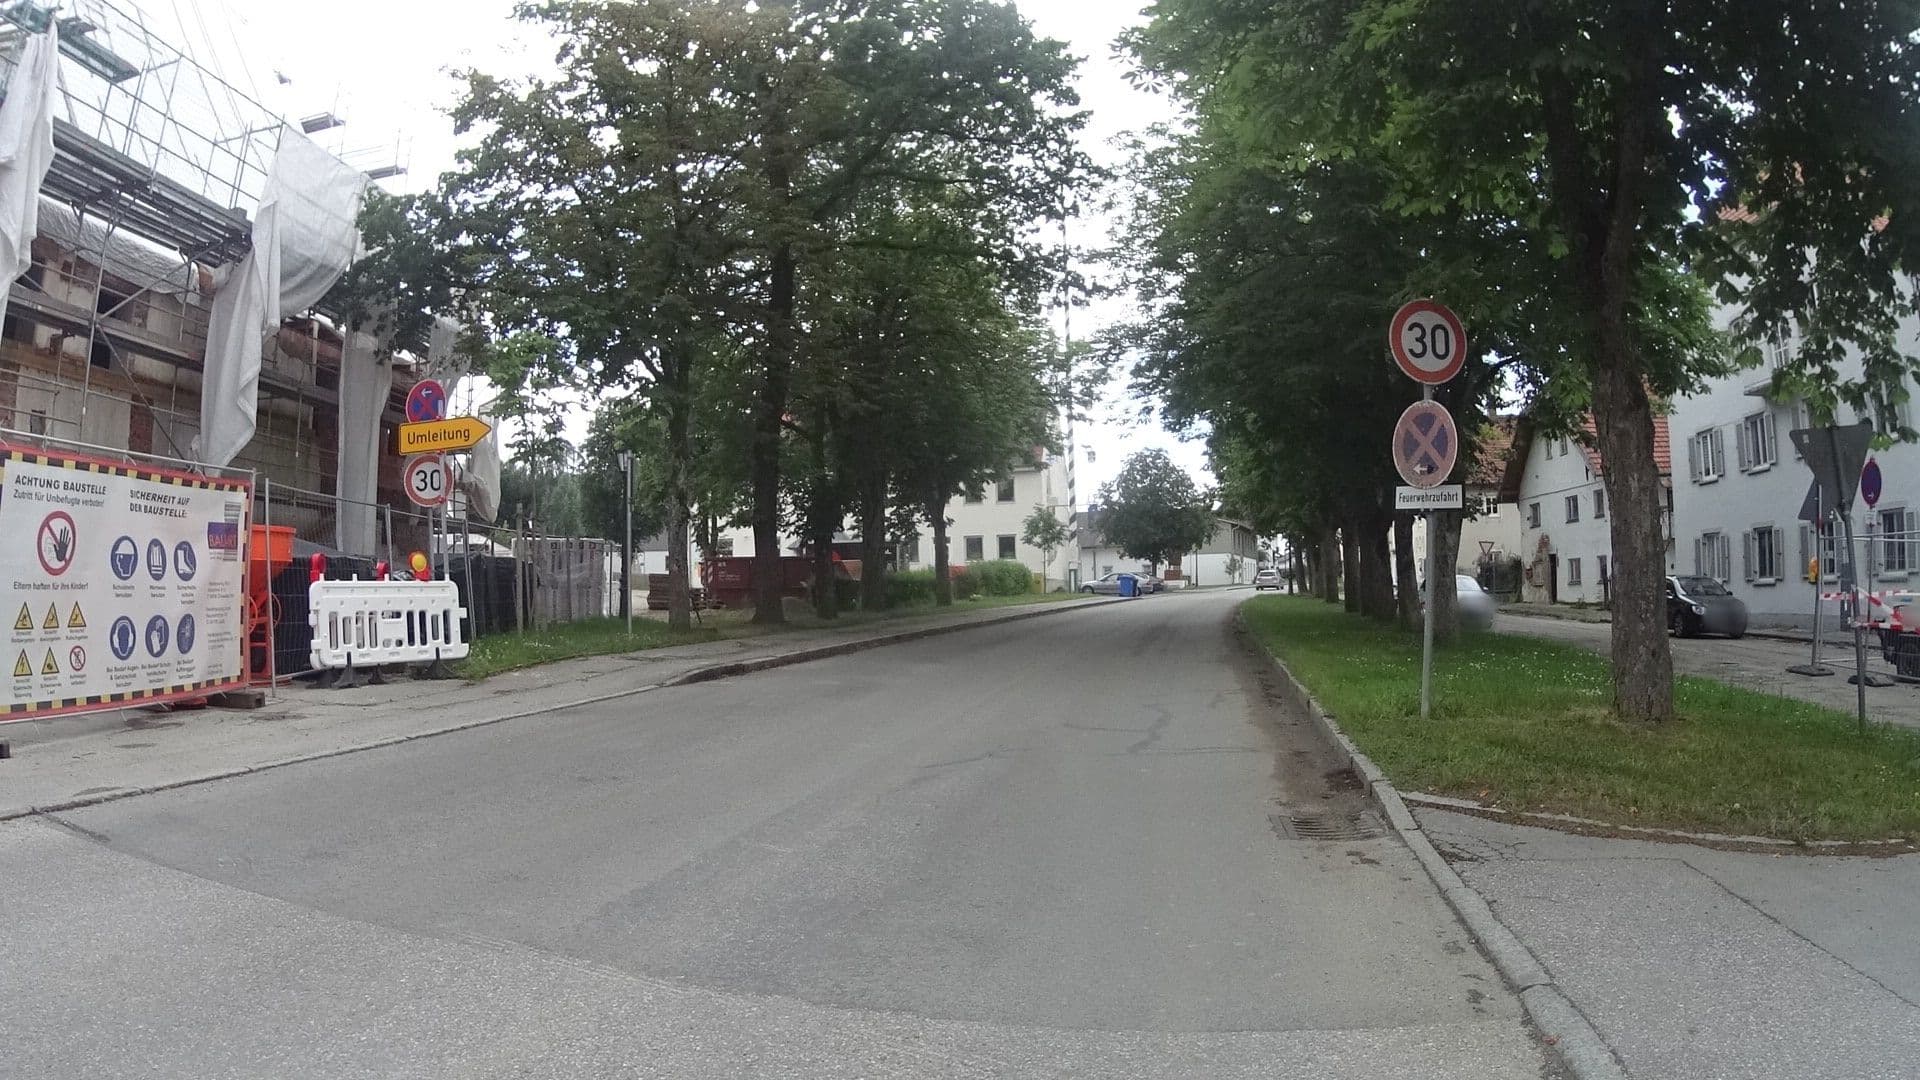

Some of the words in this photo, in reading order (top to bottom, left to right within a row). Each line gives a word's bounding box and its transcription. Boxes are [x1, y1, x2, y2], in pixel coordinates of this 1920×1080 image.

[1407, 322, 1450, 360] 30
[408, 429, 470, 444] Umleitung
[15, 475, 60, 489] ACHTUNG
[63, 481, 107, 495] BAUSTELLE
[415, 469, 441, 492] 30
[13, 489, 33, 500] Zutritt
[35, 491, 45, 502] für
[46, 493, 81, 506] Unbefugte
[130, 489, 176, 505] SICHERHEIT
[177, 497, 191, 506] AUF
[1399, 491, 1458, 503] Feuerwehrzufahrt
[130, 502, 142, 512] DER
[143, 505, 188, 518] BAUSTELLE:
[13, 581, 32, 590] Eltern
[33, 582, 51, 591] haften
[52, 582, 60, 591] für
[71, 582, 88, 590] Kinder!
